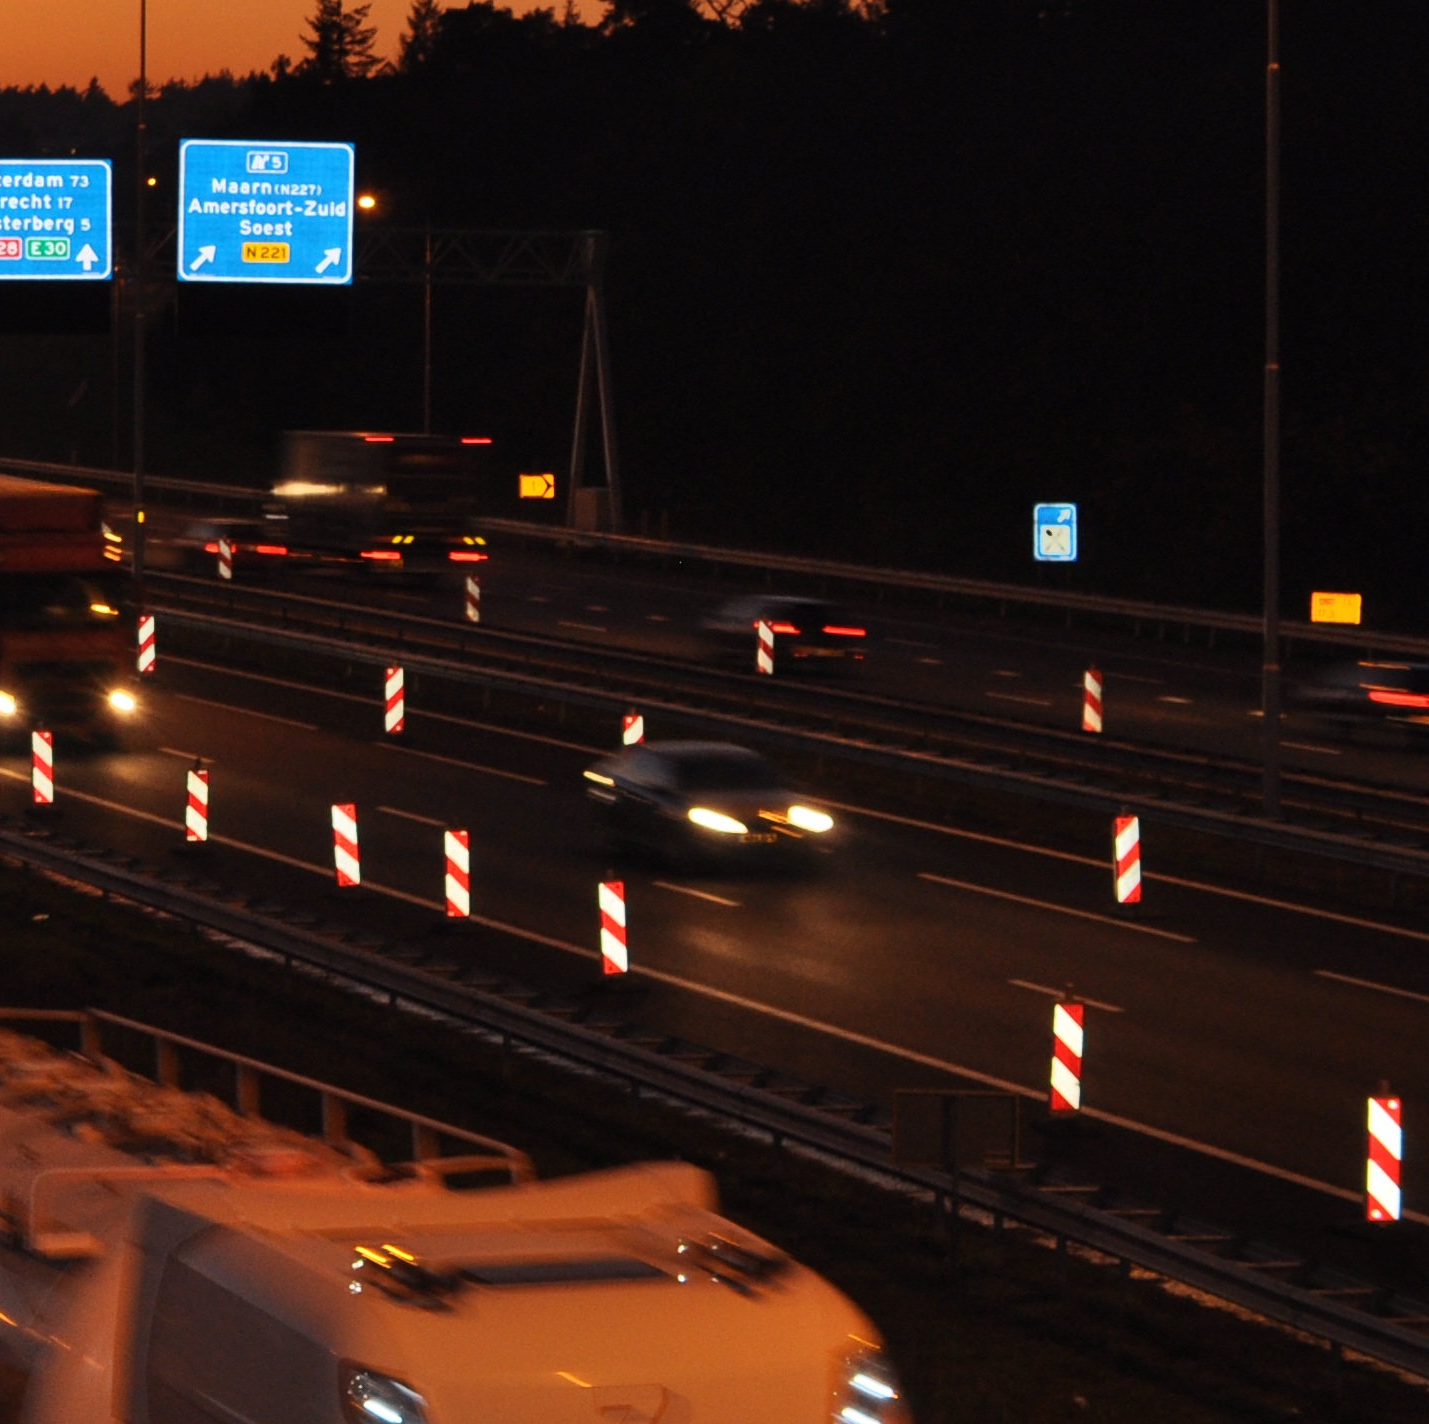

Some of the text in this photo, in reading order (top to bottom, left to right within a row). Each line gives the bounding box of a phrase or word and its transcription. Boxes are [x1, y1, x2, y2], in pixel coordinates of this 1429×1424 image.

[272, 156, 282, 169] 5
[70, 175, 90, 188] 73
[212, 178, 322, 196] Maarn (N227)
[57, 197, 73, 209] 17
[188, 197, 346, 217] Amersfoort-Zuid
[80, 218, 91, 231] 5
[239, 219, 293, 236] Soest
